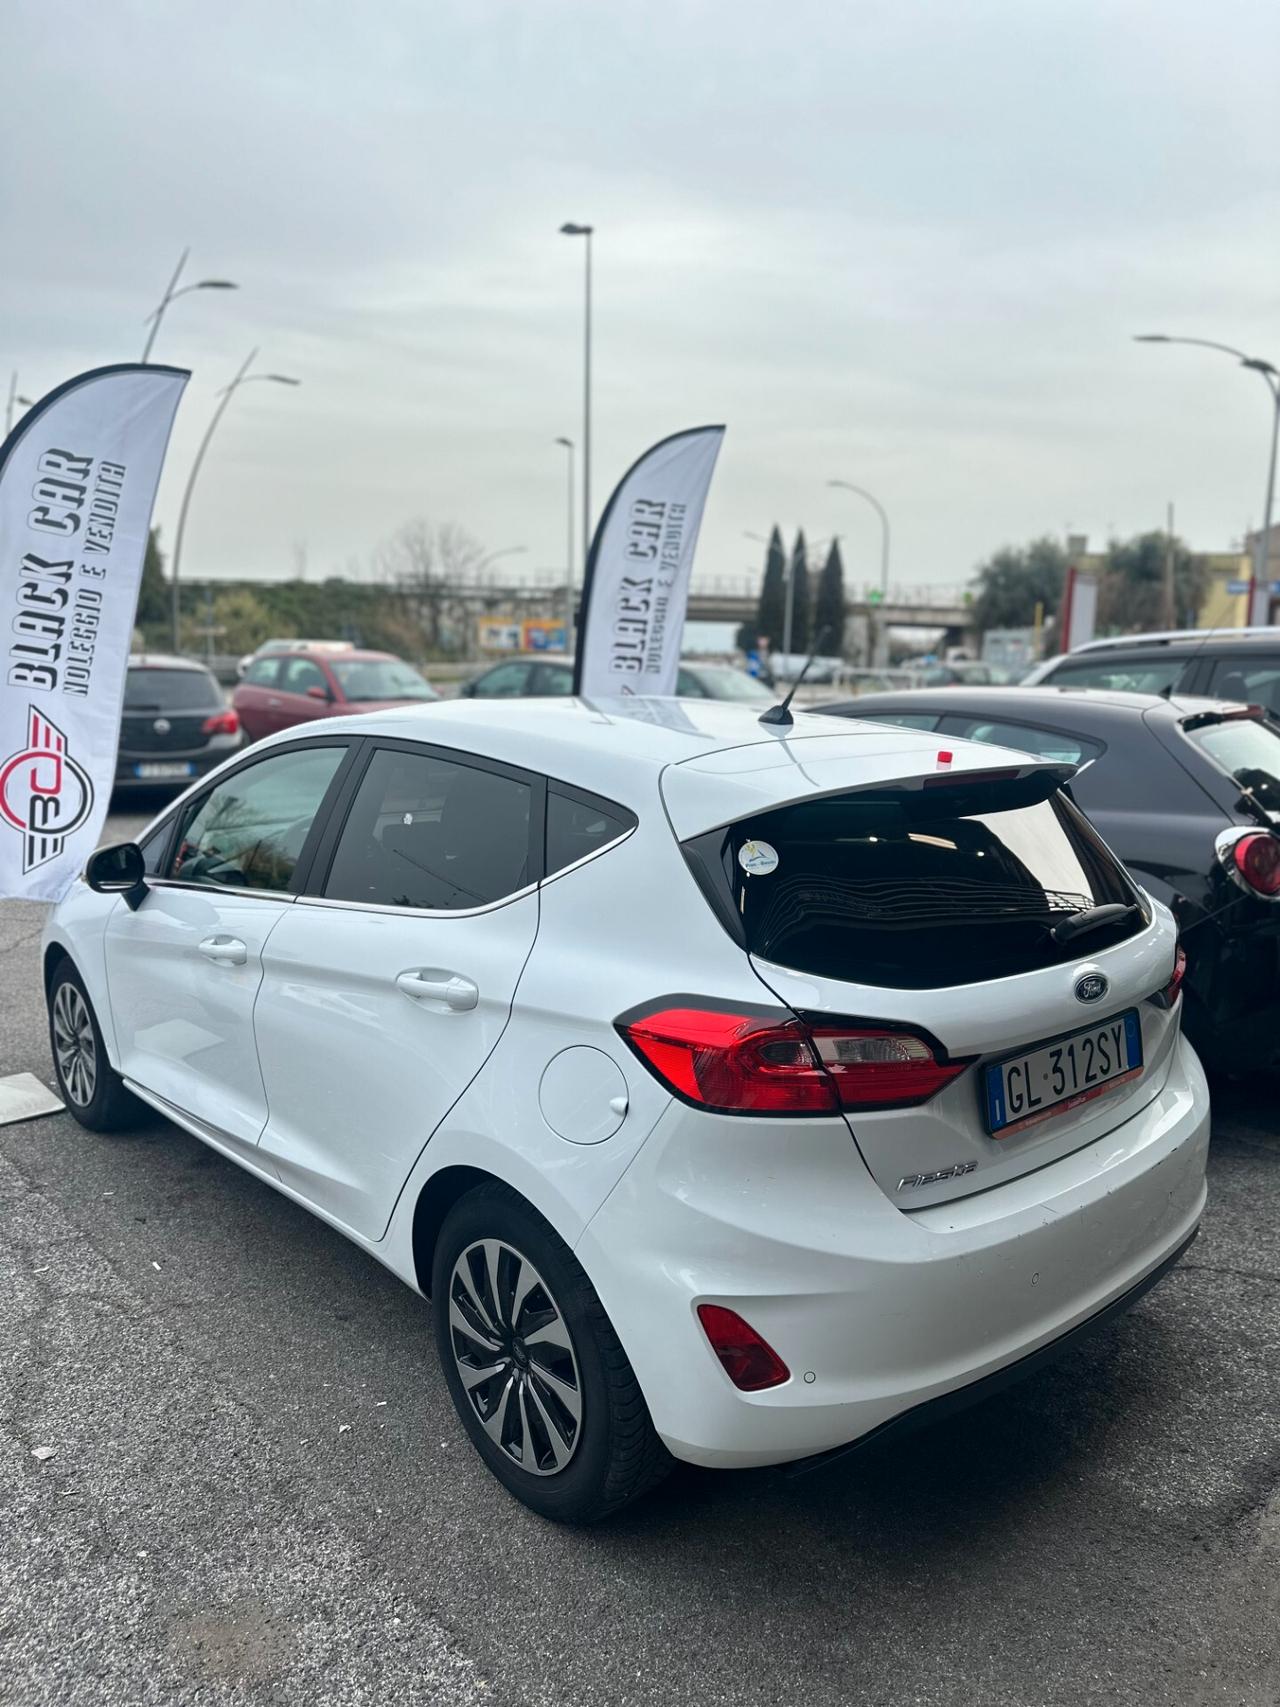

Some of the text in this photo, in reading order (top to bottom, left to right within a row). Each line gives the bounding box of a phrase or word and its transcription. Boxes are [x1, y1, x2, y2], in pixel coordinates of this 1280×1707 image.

[7, 448, 94, 693] BLACK CAR
[62, 460, 127, 698] NOLEGGIO E VENDITA
[608, 498, 667, 675] BLACK CAR
